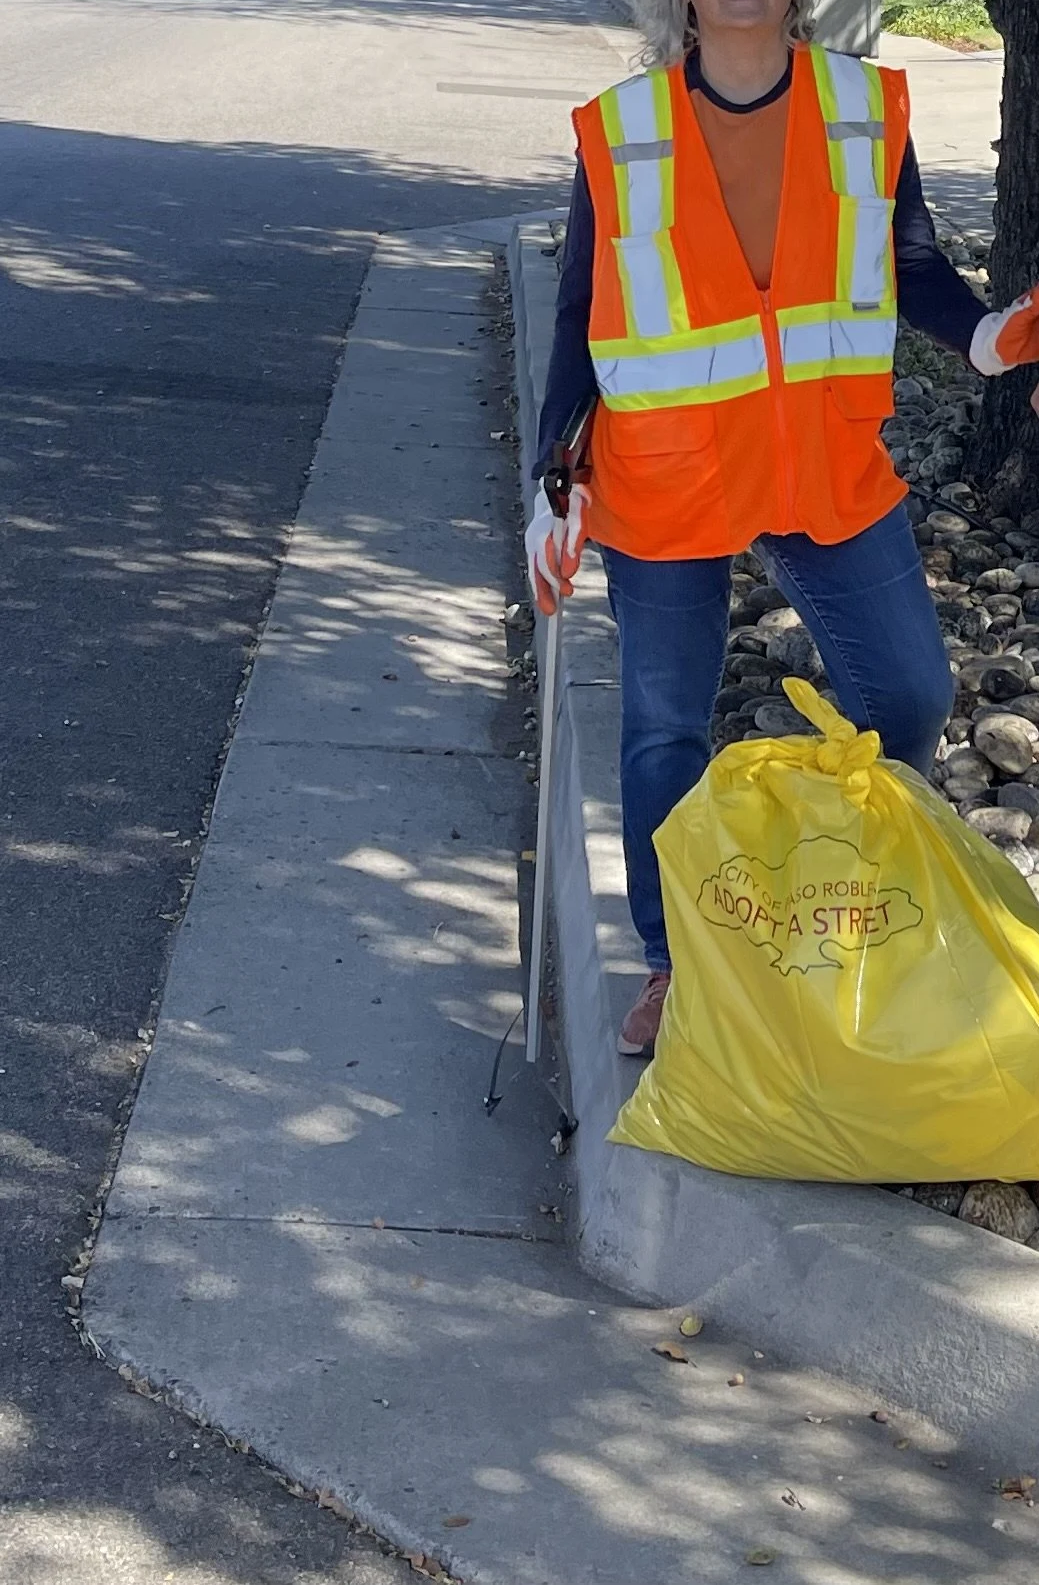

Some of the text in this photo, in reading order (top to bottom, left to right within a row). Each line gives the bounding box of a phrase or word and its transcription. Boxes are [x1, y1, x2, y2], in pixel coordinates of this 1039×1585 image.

[714, 883, 784, 939] ADOPT
[787, 913, 803, 941] A
[725, 865, 760, 890] CITY
[762, 891, 782, 912] OF
[823, 880, 877, 898] ROBLE
